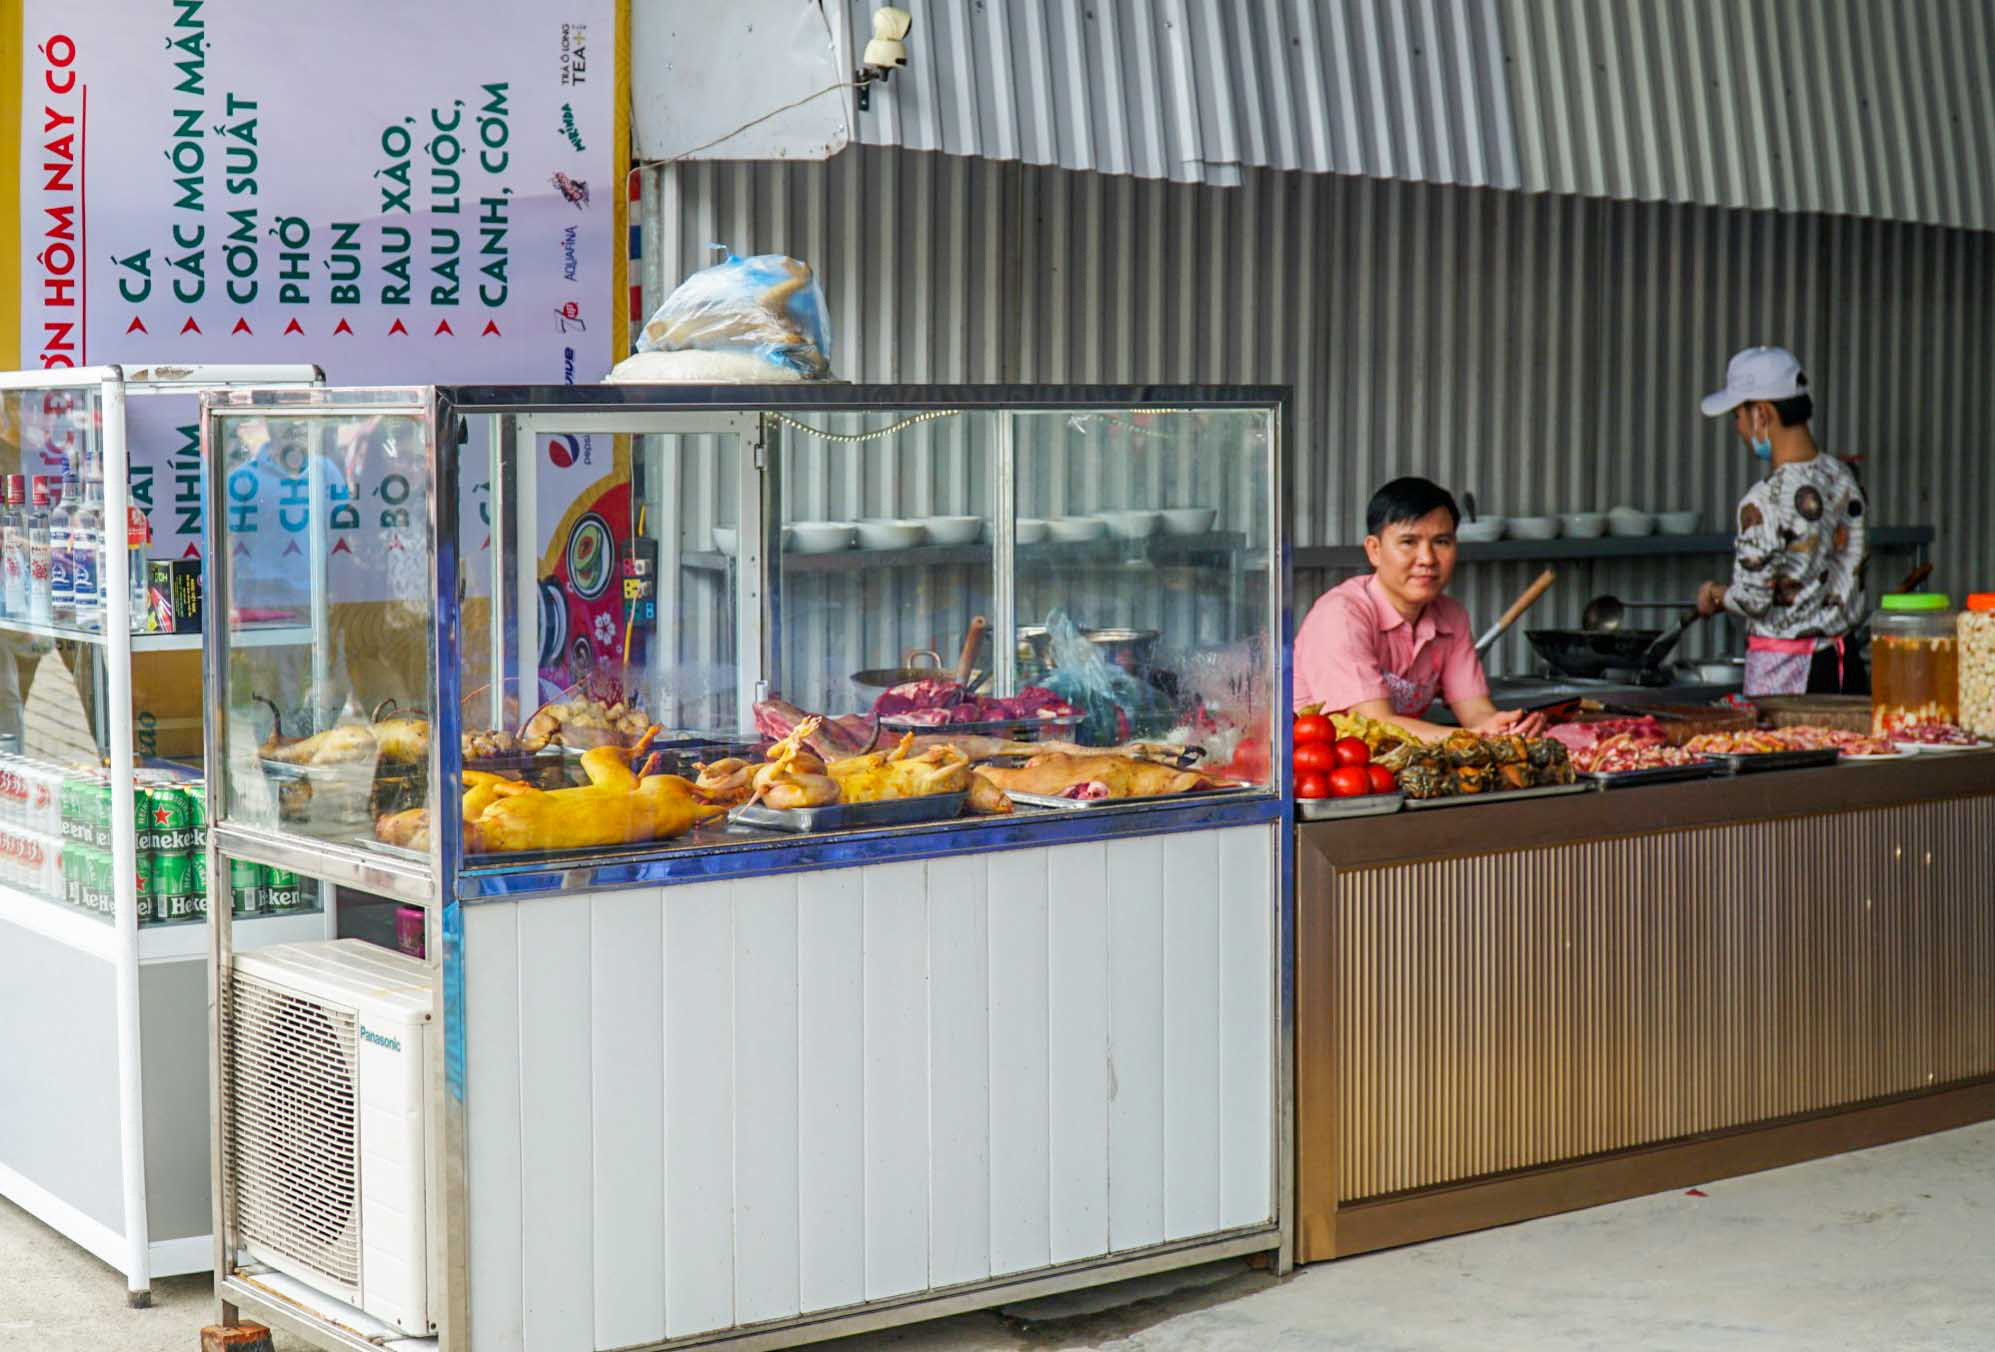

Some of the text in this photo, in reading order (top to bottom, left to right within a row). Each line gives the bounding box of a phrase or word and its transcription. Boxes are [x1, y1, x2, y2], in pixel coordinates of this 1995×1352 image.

[38, 34, 76, 94] CÓ
[45, 106, 74, 191] NAY
[164, 0, 211, 304] CÁC MÓN MẶN
[475, 82, 513, 308] CANH, CƠM
[213, 92, 258, 305] CƠM SUẤT
[373, 116, 416, 305] RAU XÀO,
[424, 100, 466, 306] RAU LUỘC,
[37, 206, 75, 306] HÔM
[110, 249, 151, 304] CÁ
[268, 216, 311, 304] PHỞ
[323, 223, 361, 304] BÚN
[166, 424, 202, 534] NHÍM
[372, 473, 410, 528] BÒ
[360, 1025, 401, 1052] Panasonic
